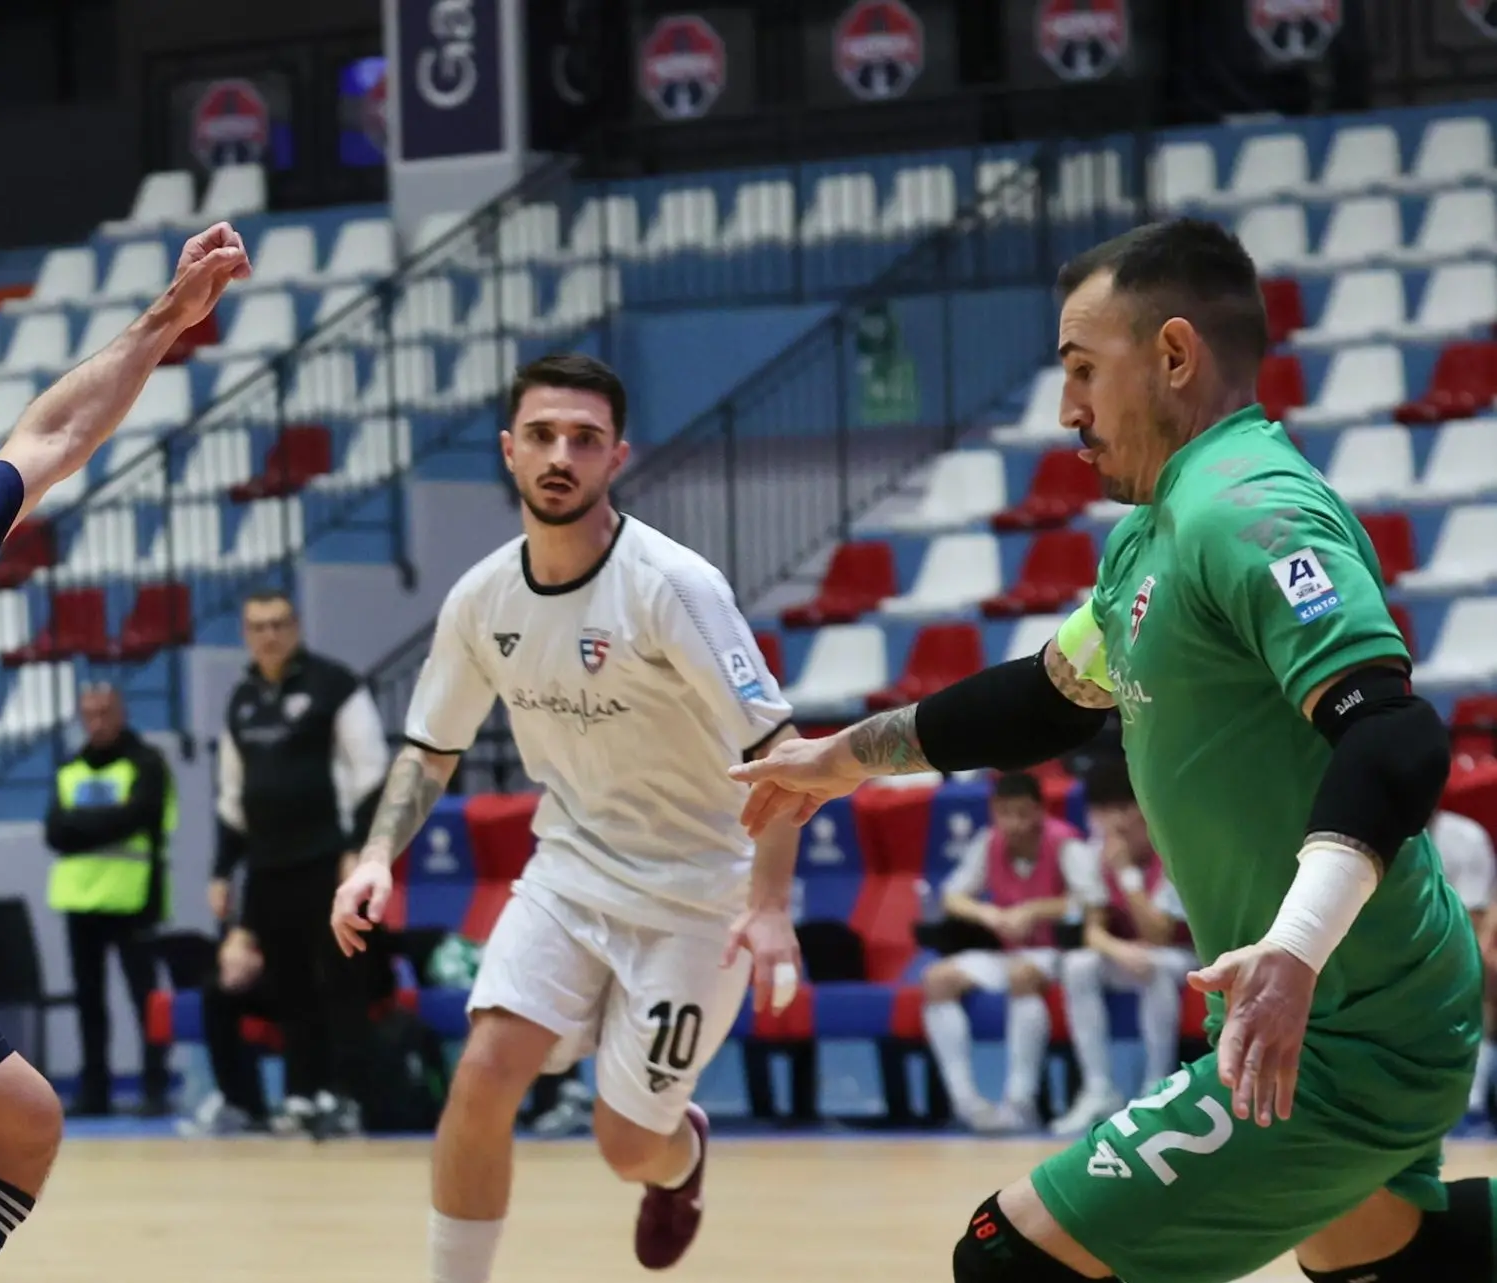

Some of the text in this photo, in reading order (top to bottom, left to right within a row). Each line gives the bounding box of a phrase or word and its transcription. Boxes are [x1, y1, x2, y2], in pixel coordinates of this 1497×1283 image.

[1288, 557, 1316, 588] A
[1335, 689, 1365, 715] DANI
[648, 1000, 704, 1070] 10
[1110, 1069, 1233, 1187] 22
